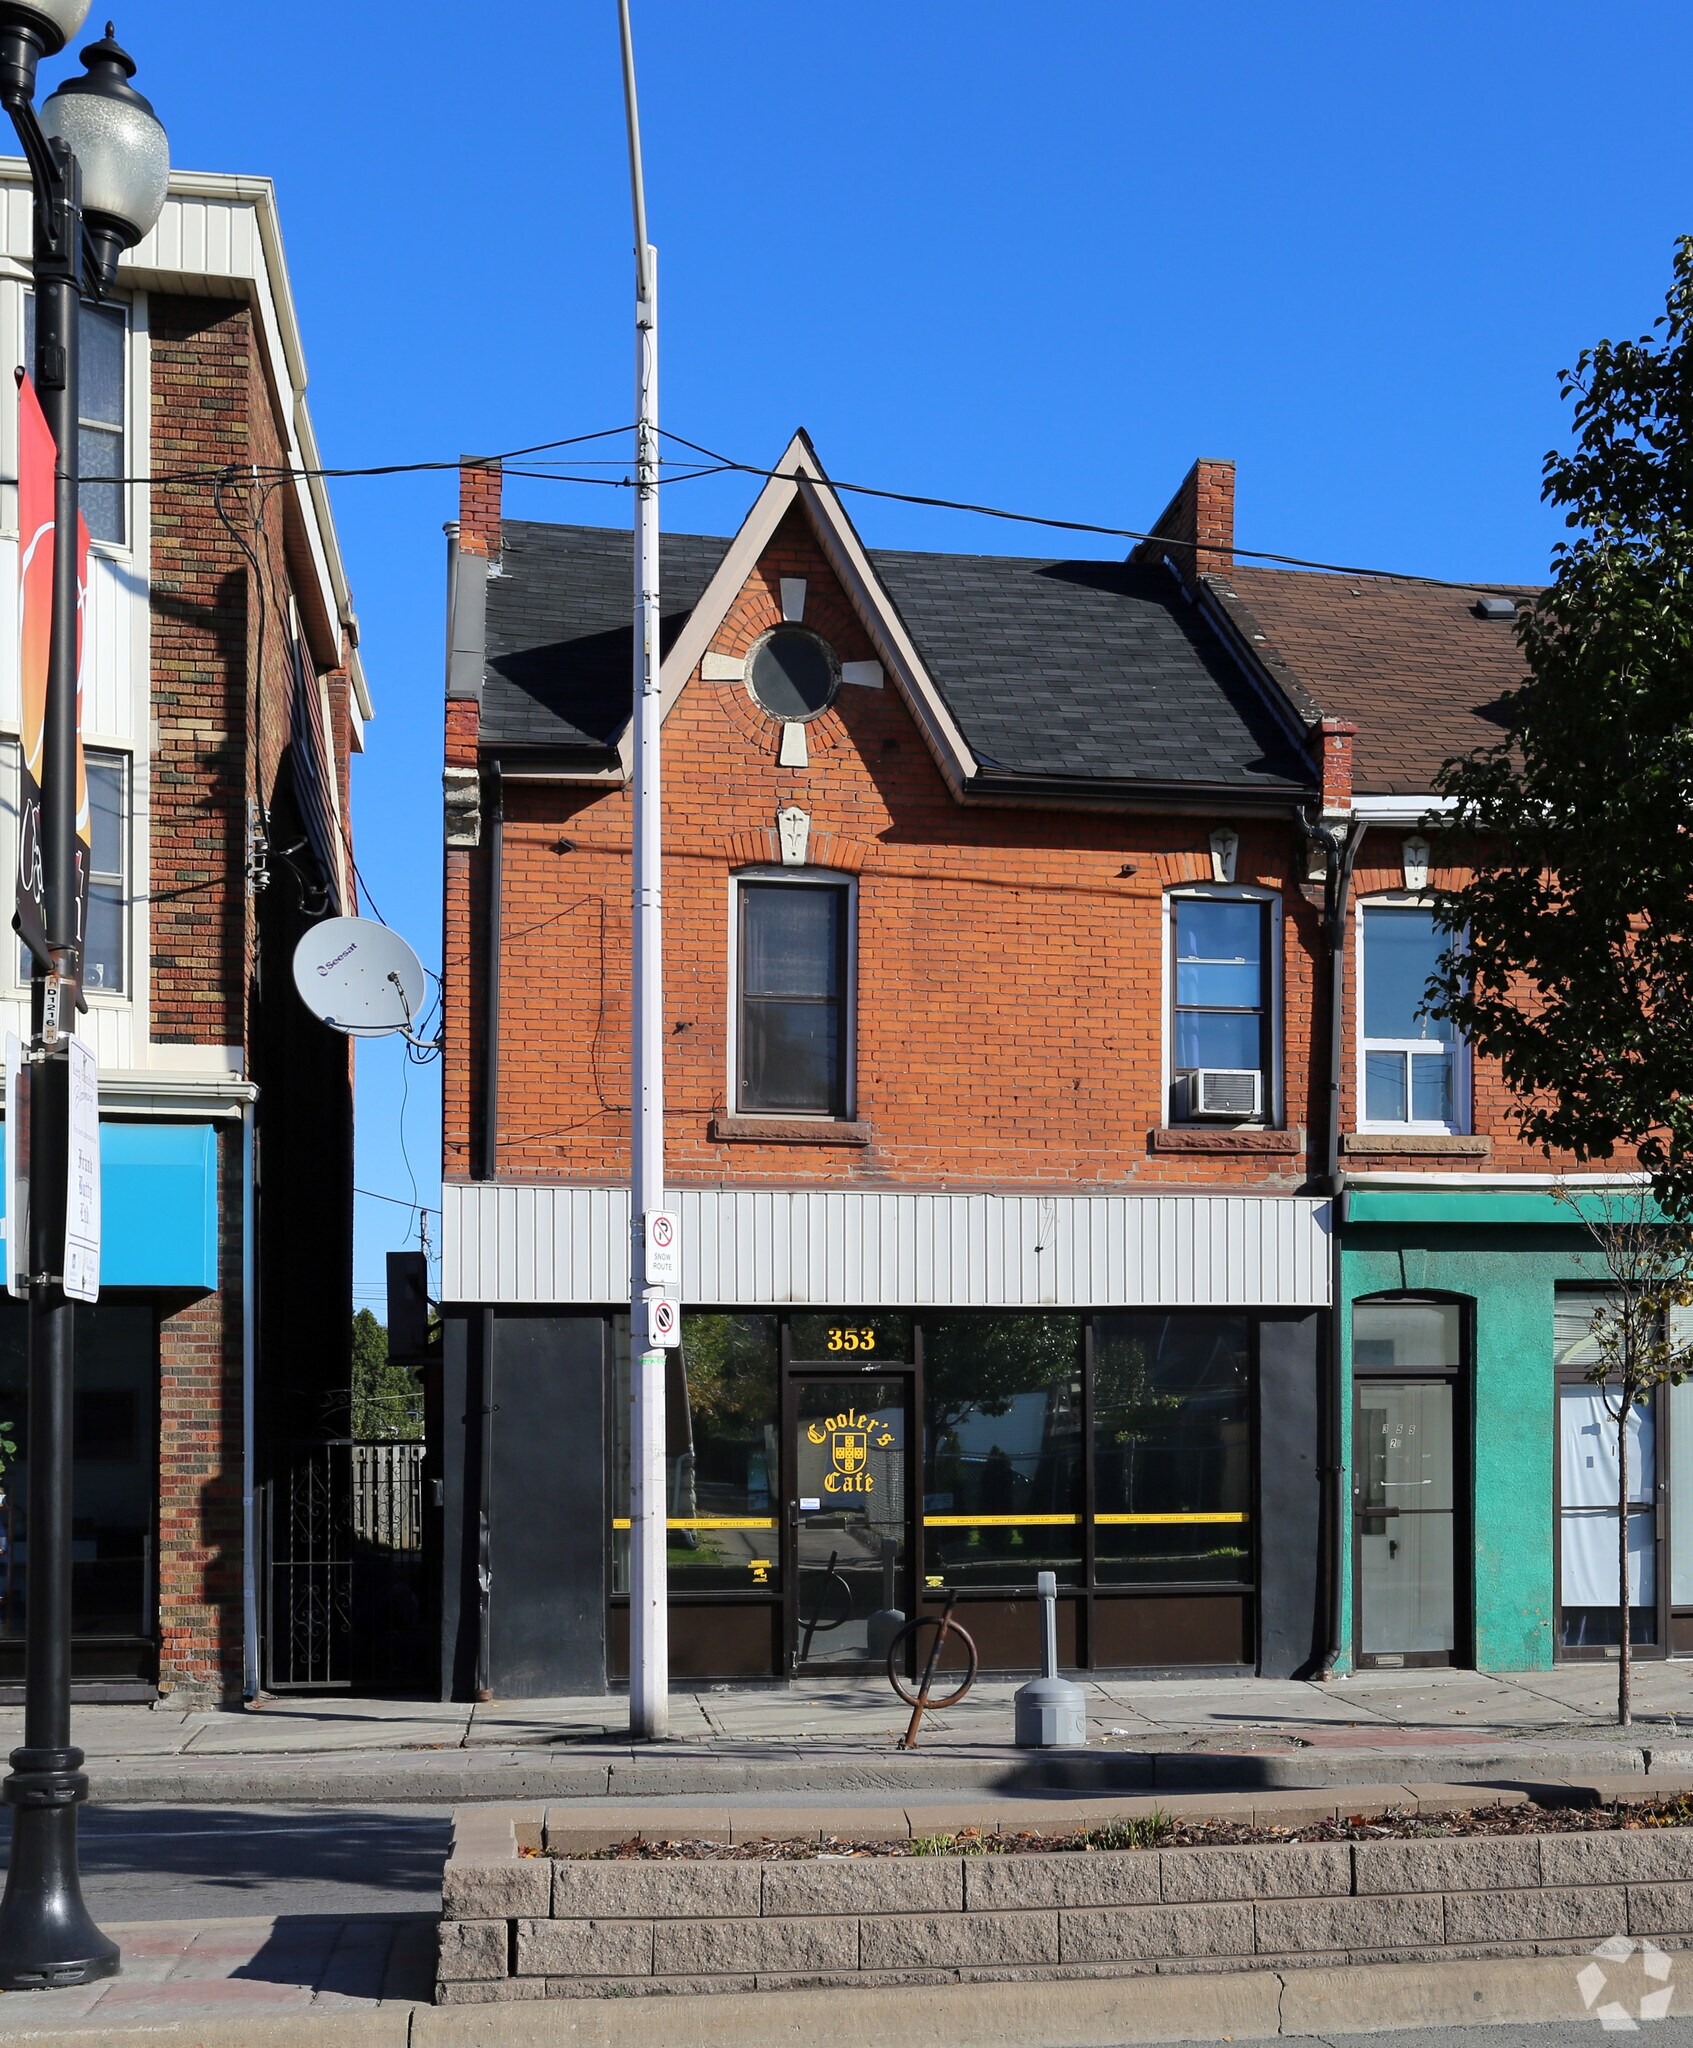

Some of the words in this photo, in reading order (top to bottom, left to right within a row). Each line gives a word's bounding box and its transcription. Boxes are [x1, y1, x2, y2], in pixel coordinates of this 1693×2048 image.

[326, 943, 358, 970] Seesat
[46, 989, 57, 1027] D1216
[653, 1262, 672, 1271] ROUTE
[654, 1252, 671, 1261] SNOW
[827, 1327, 875, 1351] 353
[807, 1407, 895, 1447] Cooler's
[824, 1471, 875, 1493] Café
